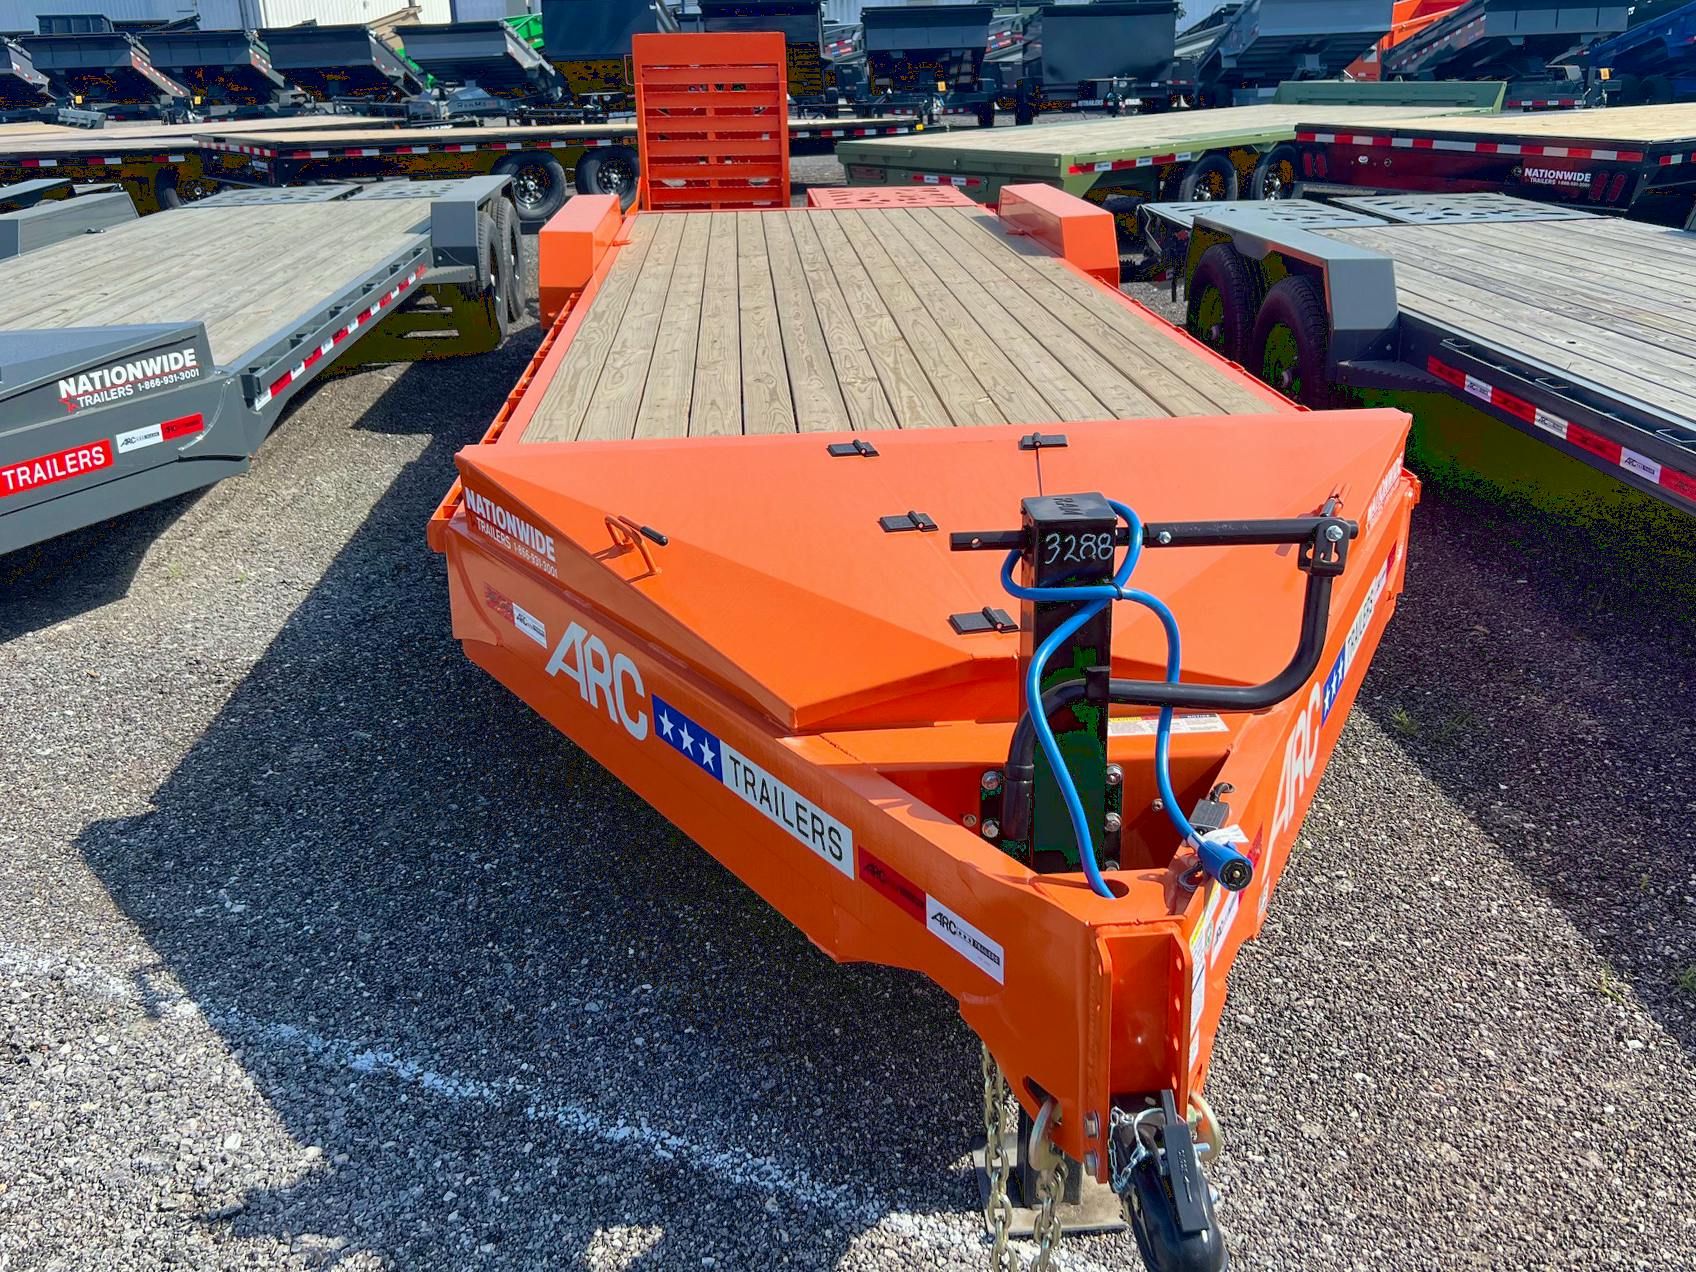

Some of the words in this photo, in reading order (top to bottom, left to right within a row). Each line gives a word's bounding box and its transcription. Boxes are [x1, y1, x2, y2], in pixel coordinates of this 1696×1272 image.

[1524, 168, 1592, 182] NATIONWIDE
[58, 348, 197, 399] NATIONWIDE
[77, 384, 134, 409] TRAILERS
[137, 368, 200, 392] 1-866-931-3001
[2, 446, 106, 491] TRAILERS
[464, 486, 556, 562] NATIONWIDE
[475, 516, 512, 550] TRAILERS
[1045, 533, 1114, 565] 3288
[544, 621, 648, 741] ARC
[1262, 681, 1321, 885] ARC
[728, 754, 844, 862] TRAILERS
[931, 911, 957, 936] ARC
